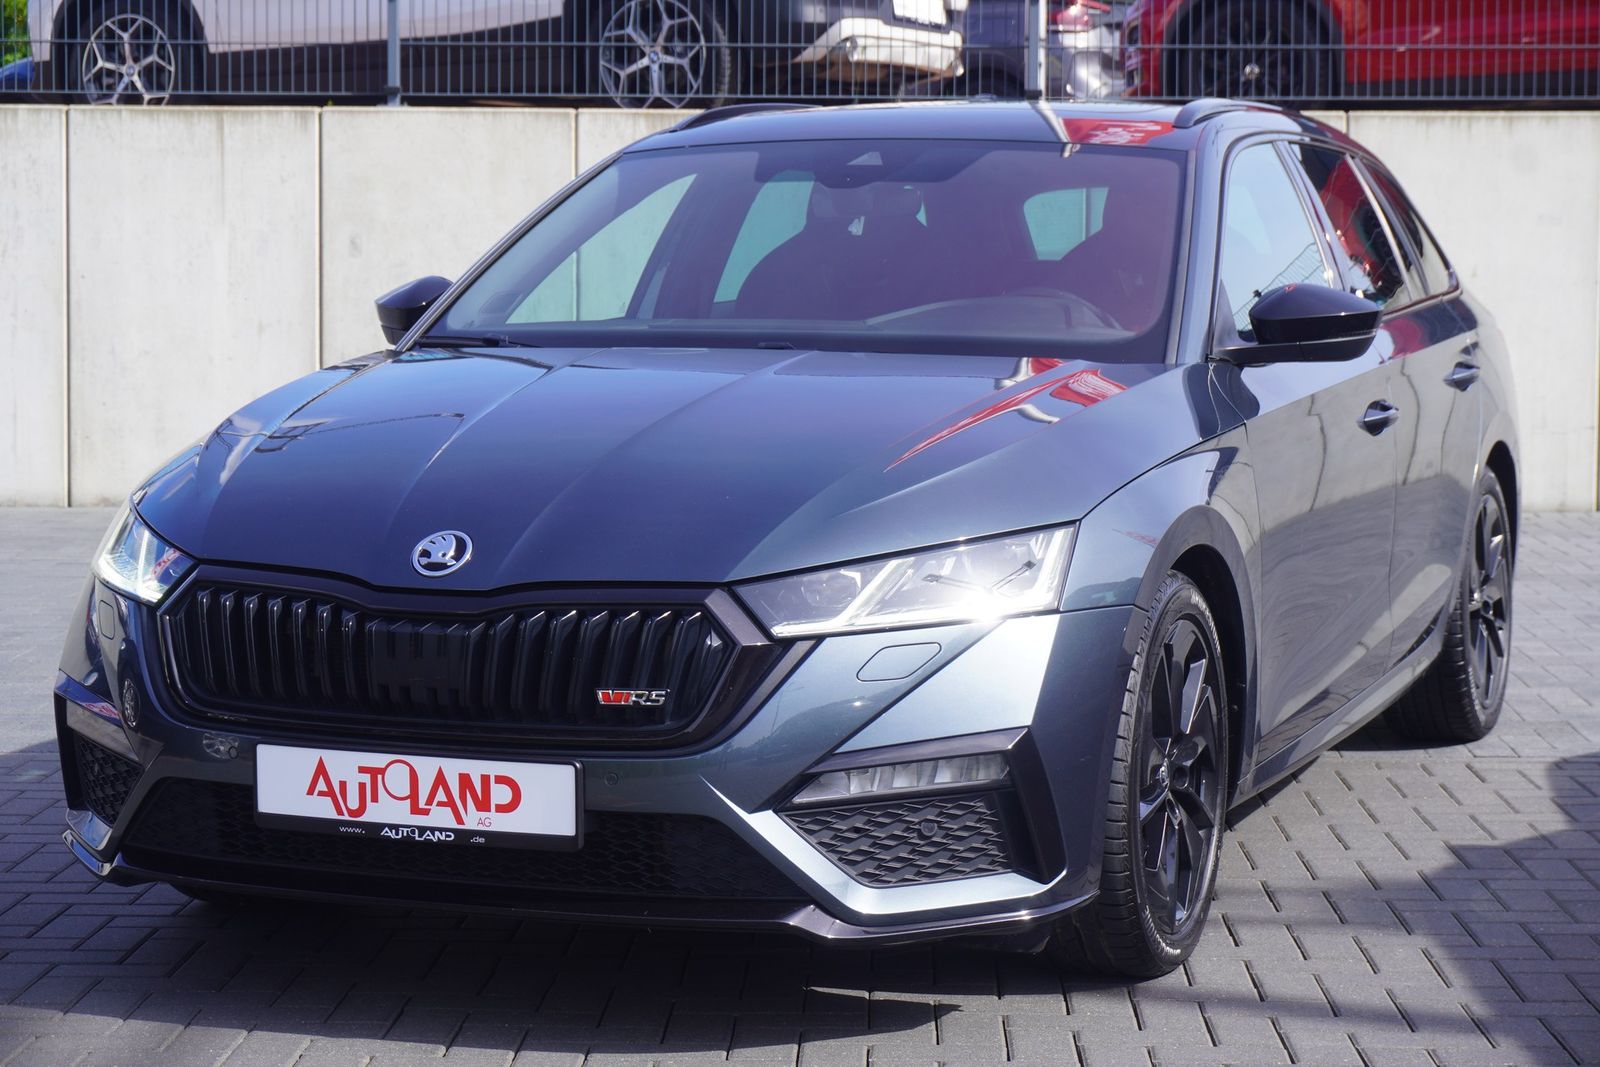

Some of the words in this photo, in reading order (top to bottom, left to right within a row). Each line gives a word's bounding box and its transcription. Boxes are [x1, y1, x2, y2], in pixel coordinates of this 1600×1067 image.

[306, 756, 522, 826] AUTOLAND
[476, 817, 492, 828] AG
[338, 826, 366, 834] www.
[380, 826, 455, 842] AUTOLAND
[470, 836, 486, 844] .de
